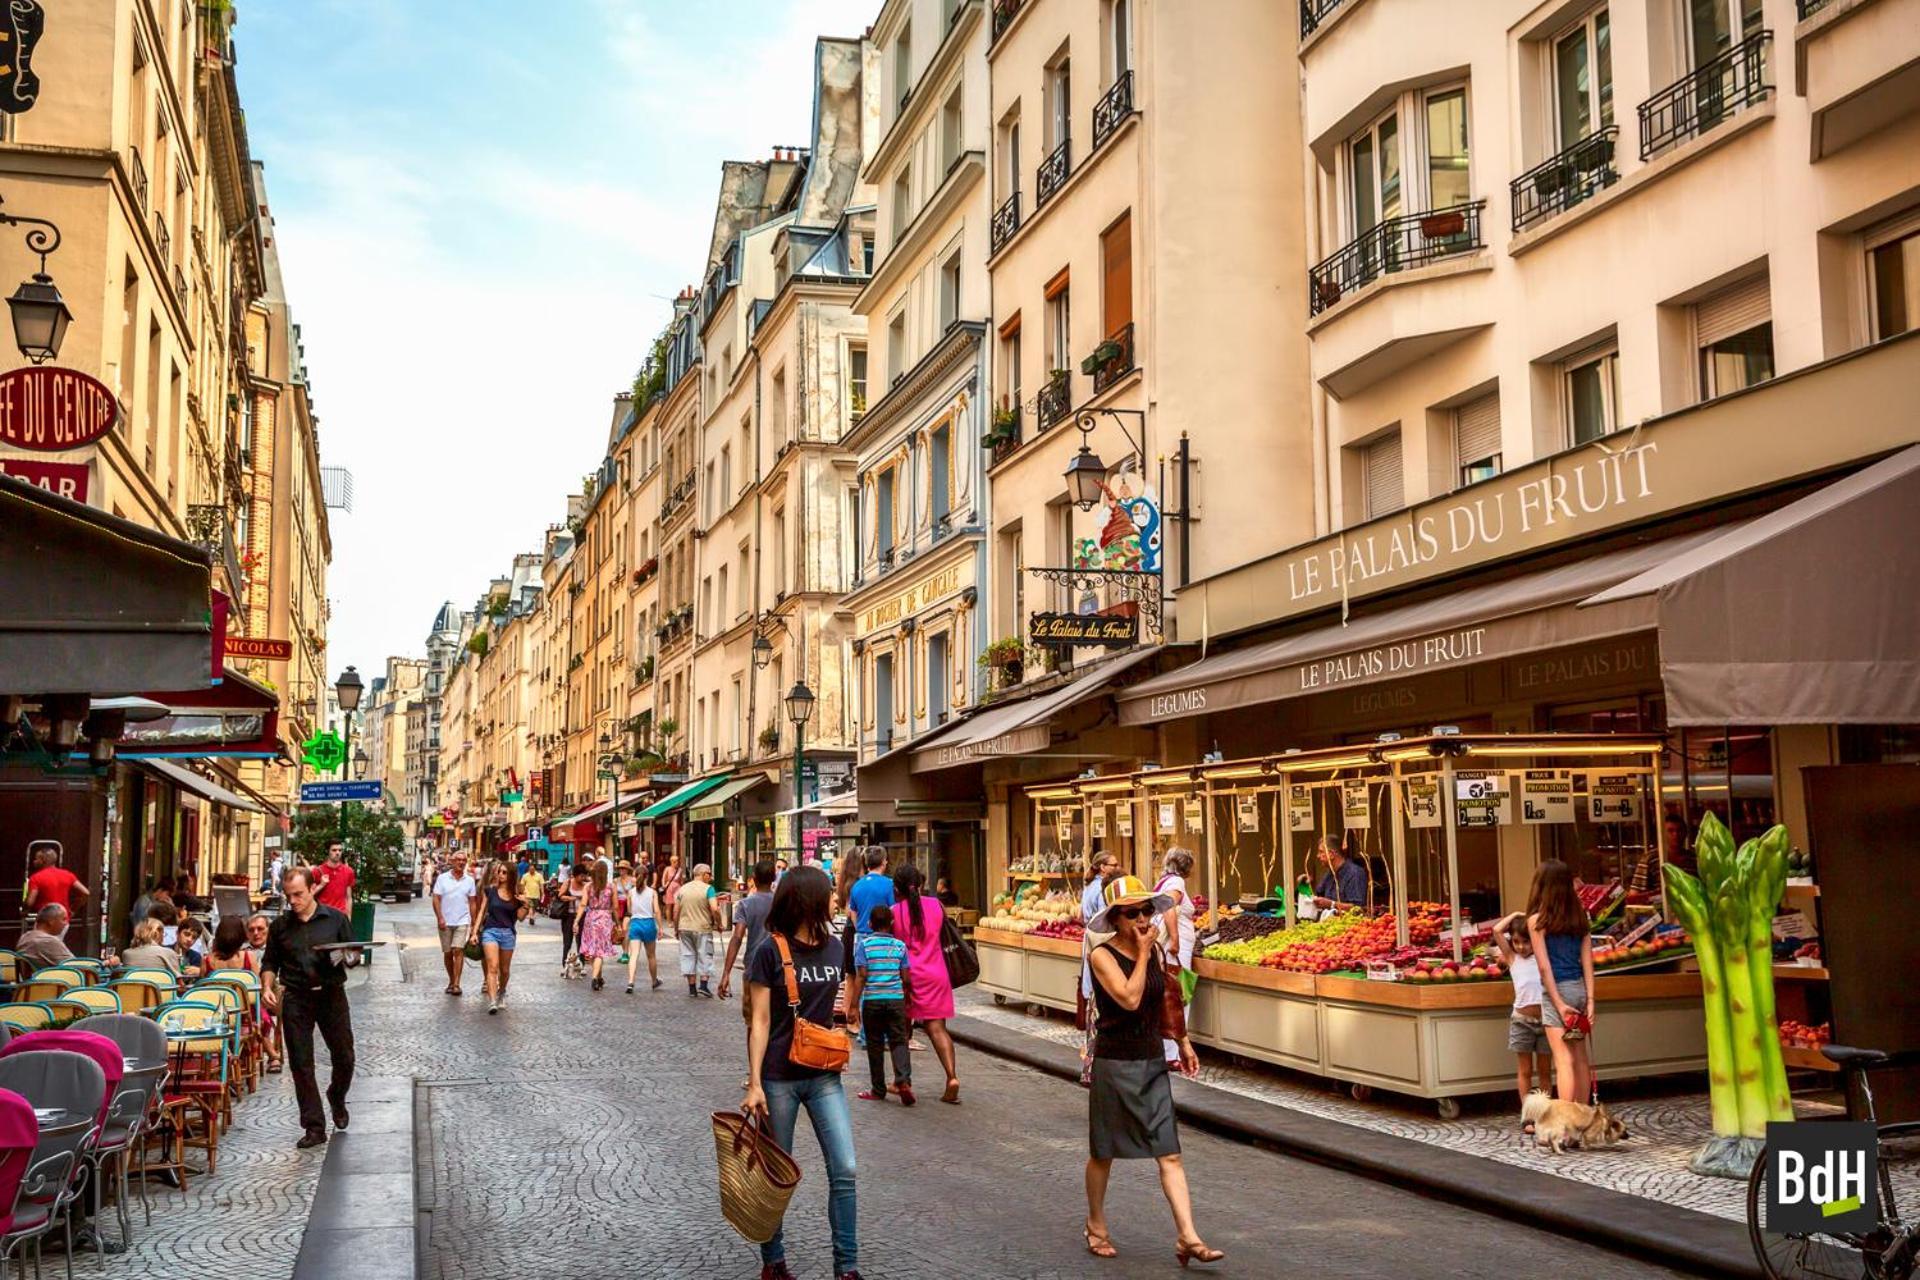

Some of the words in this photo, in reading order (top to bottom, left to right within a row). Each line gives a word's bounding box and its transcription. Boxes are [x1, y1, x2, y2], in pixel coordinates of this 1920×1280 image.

[23, 373, 45, 444] DU
[53, 373, 110, 444] CENTRE
[13, 474, 77, 501] AR
[1287, 555, 1322, 601] LE
[1328, 516, 1439, 590] PALAIS
[1447, 492, 1505, 554] DU
[1517, 442, 1658, 533] FRUIT
[1032, 619, 1048, 637] Le
[1048, 618, 1083, 638] Palais
[1084, 621, 1100, 638] du
[1103, 621, 1131, 639] Fruit
[224, 640, 284, 656] NICOLAS
[1300, 664, 1320, 690] LE
[1325, 649, 1383, 684] PALAIS
[1389, 642, 1417, 672] DU
[1424, 628, 1486, 665] FRUIT
[1518, 663, 1540, 689] LE
[1544, 651, 1610, 683] PALAIS
[1615, 645, 1646, 672] DU
[1151, 688, 1207, 717] LEGUMES
[1526, 783, 1569, 793] PROMOTION
